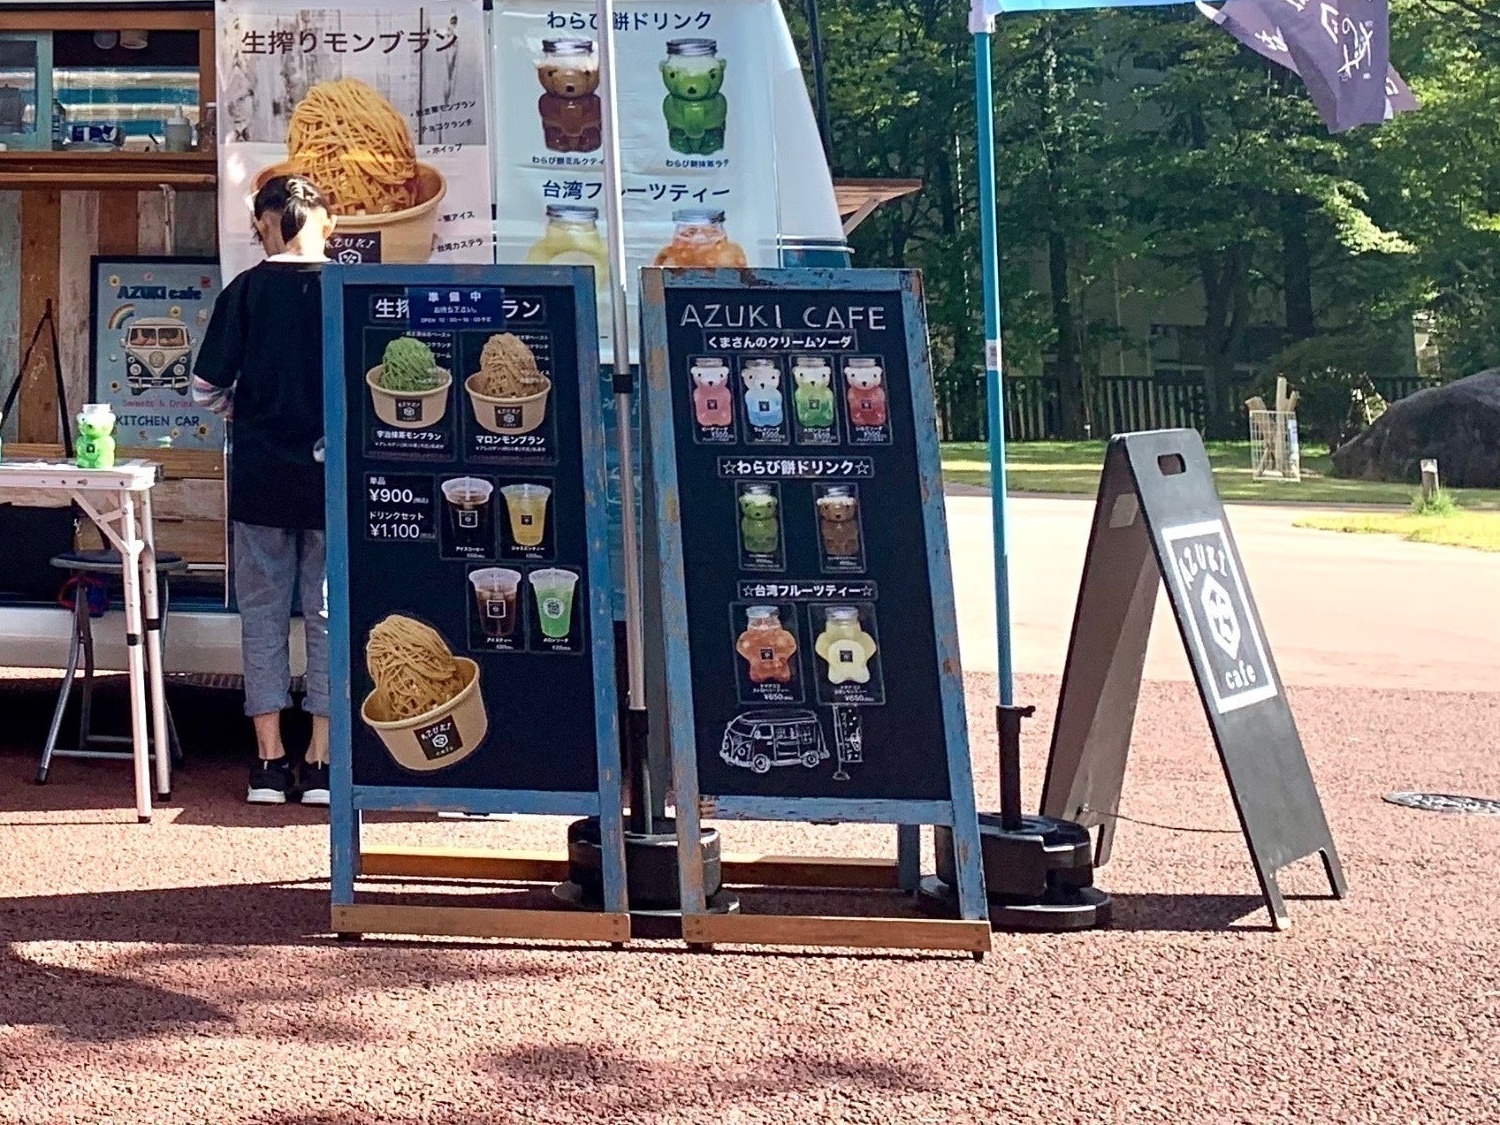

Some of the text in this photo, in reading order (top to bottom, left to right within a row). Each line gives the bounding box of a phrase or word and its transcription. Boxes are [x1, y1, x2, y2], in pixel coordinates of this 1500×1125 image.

[241, 29, 459, 55] 生搾りモンブラン
[680, 303, 887, 330] AZUKI CAFE
[708, 335, 852, 349] くまさんのクリームソーダ
[115, 415, 200, 427] KITCHEN CAR
[475, 435, 545, 445] マロンモンブラン
[736, 459, 855, 475] わらび餅ドリンク
[369, 488, 413, 503] ¥900
[369, 512, 425, 521] ドリンクセット
[1178, 543, 1228, 591] AZUKI
[753, 584, 862, 597] 台湾フルーツティー
[1225, 659, 1257, 690] cafe
